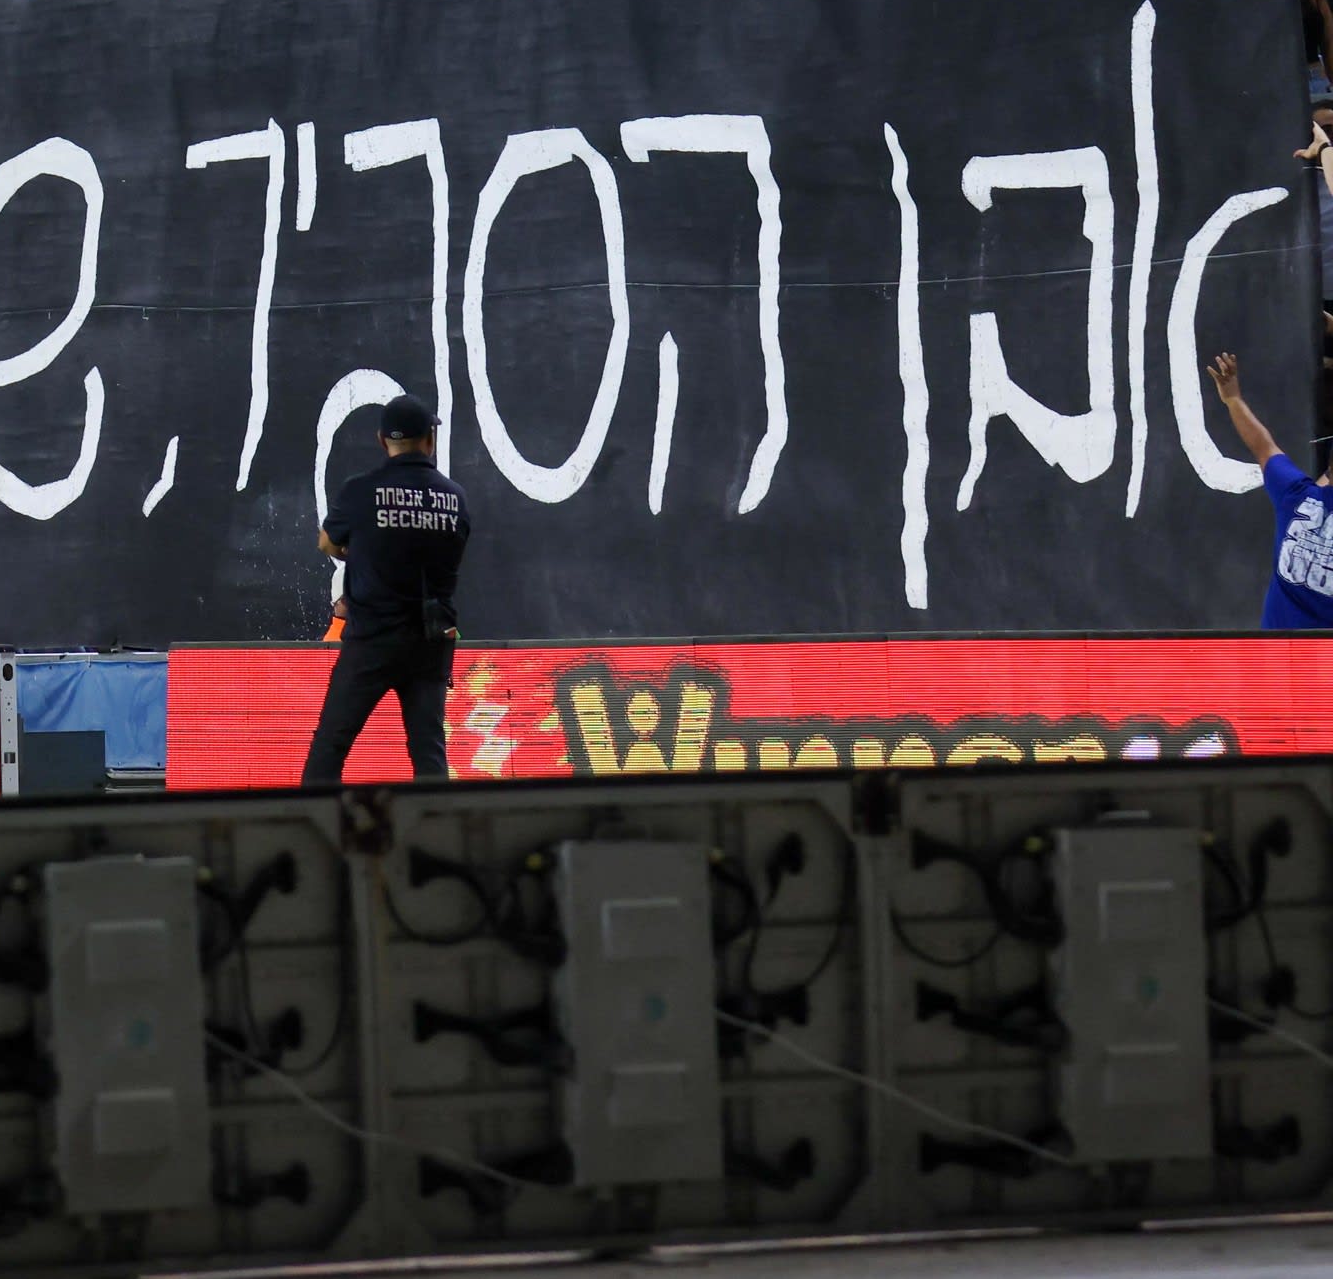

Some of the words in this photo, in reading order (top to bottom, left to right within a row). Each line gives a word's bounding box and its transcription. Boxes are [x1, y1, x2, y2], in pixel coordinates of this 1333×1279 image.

[375, 487, 423, 507] אבטחה
[428, 488, 459, 512] מנהל
[377, 509, 459, 532] SECURITY
